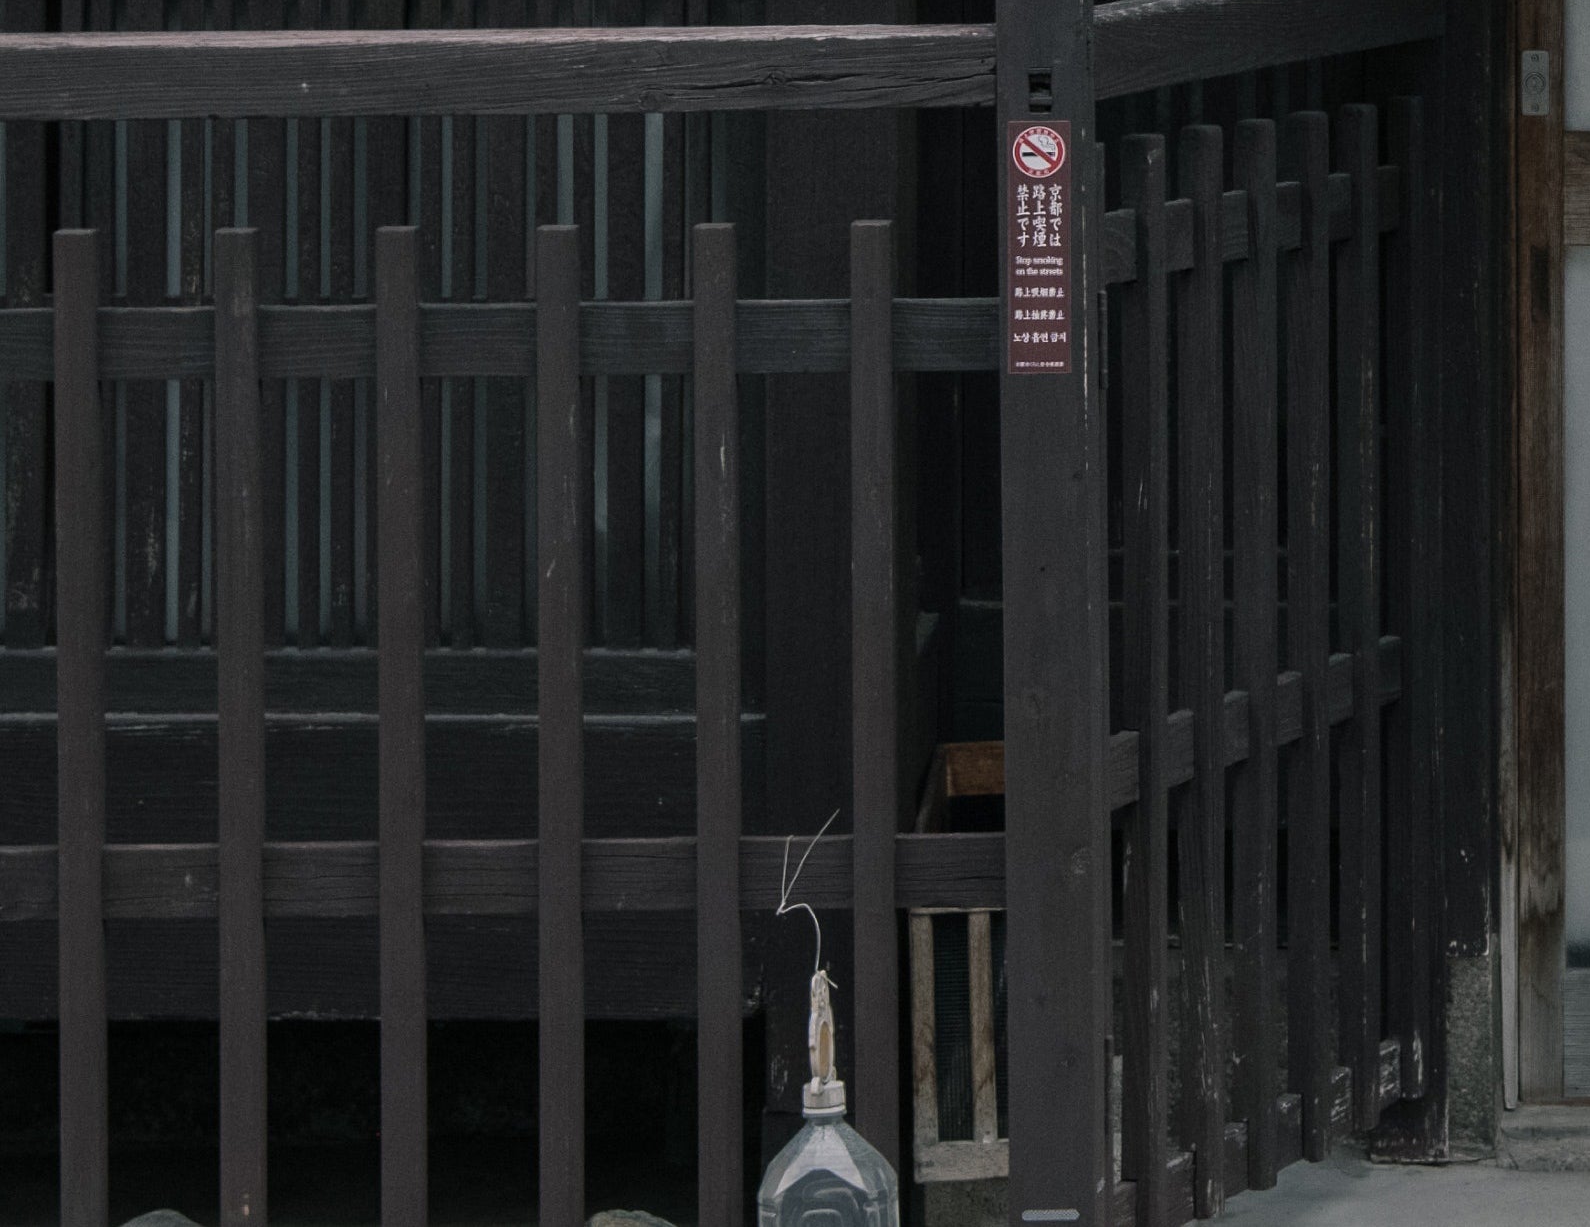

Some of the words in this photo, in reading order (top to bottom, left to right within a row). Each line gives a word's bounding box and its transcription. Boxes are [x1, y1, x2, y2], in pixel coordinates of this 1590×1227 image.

[1016, 183, 1031, 248] 禁止です
[1032, 183, 1048, 248] 路上喫煙
[1048, 183, 1064, 248] 京都では
[1015, 255, 1032, 266] Stop
[1033, 255, 1064, 266] smoking
[1015, 267, 1026, 276] on
[1026, 266, 1038, 276] the
[1039, 267, 1064, 276] streets
